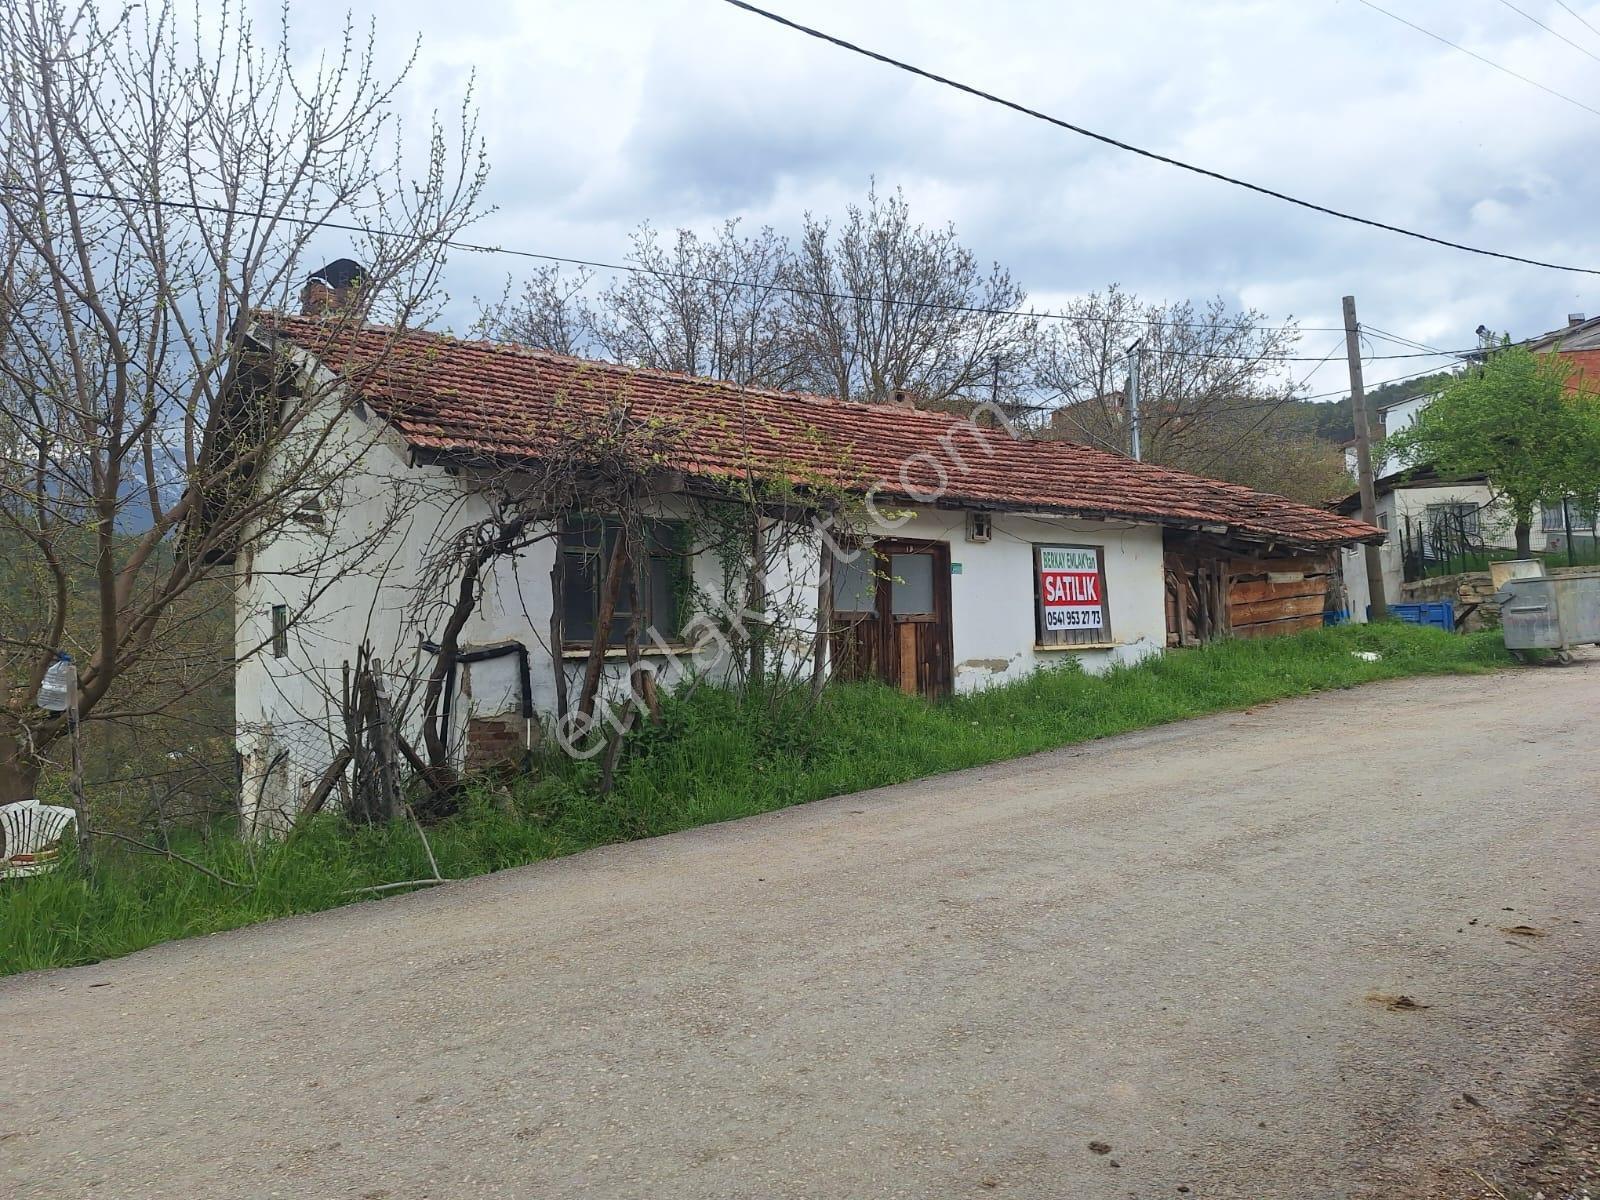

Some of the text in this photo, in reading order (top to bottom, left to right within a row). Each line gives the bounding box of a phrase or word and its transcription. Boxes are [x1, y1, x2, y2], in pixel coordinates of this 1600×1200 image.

[1045, 575, 1097, 602] SATILIK
[1047, 610, 1101, 626] 0541 953 27 73
